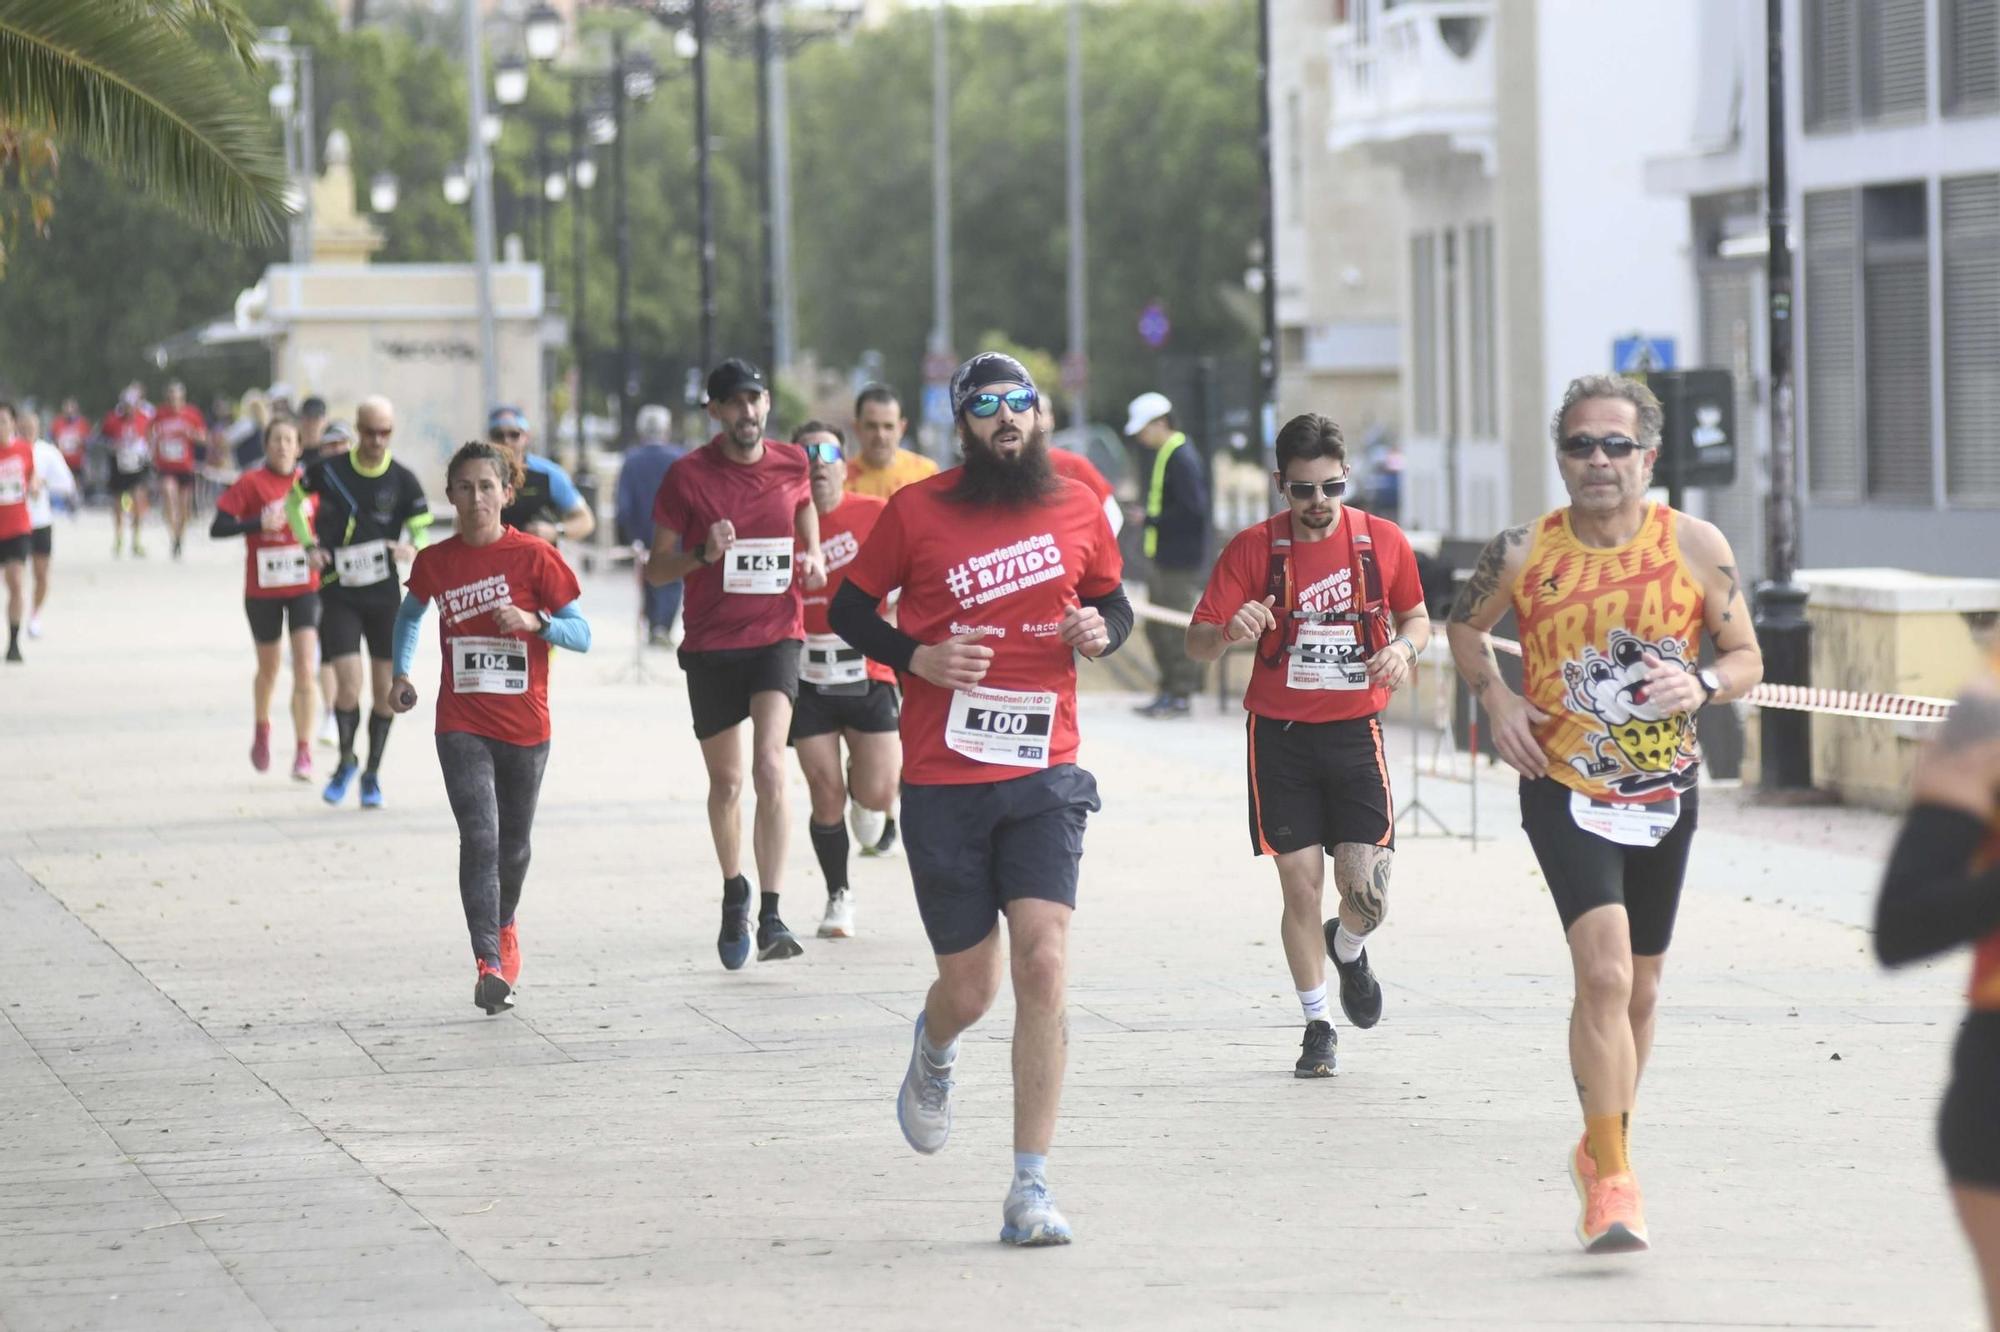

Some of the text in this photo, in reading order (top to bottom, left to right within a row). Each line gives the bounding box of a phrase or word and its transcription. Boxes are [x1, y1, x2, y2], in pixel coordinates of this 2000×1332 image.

[968, 533, 1055, 572] CorriendoCon
[977, 546, 1062, 588] ASSIDO
[976, 581, 1020, 604] CARRERA
[1019, 564, 1066, 589] SOLIDARIA
[1301, 581, 1352, 612] ASSID
[471, 654, 509, 670] 104
[977, 710, 1028, 735] 100
